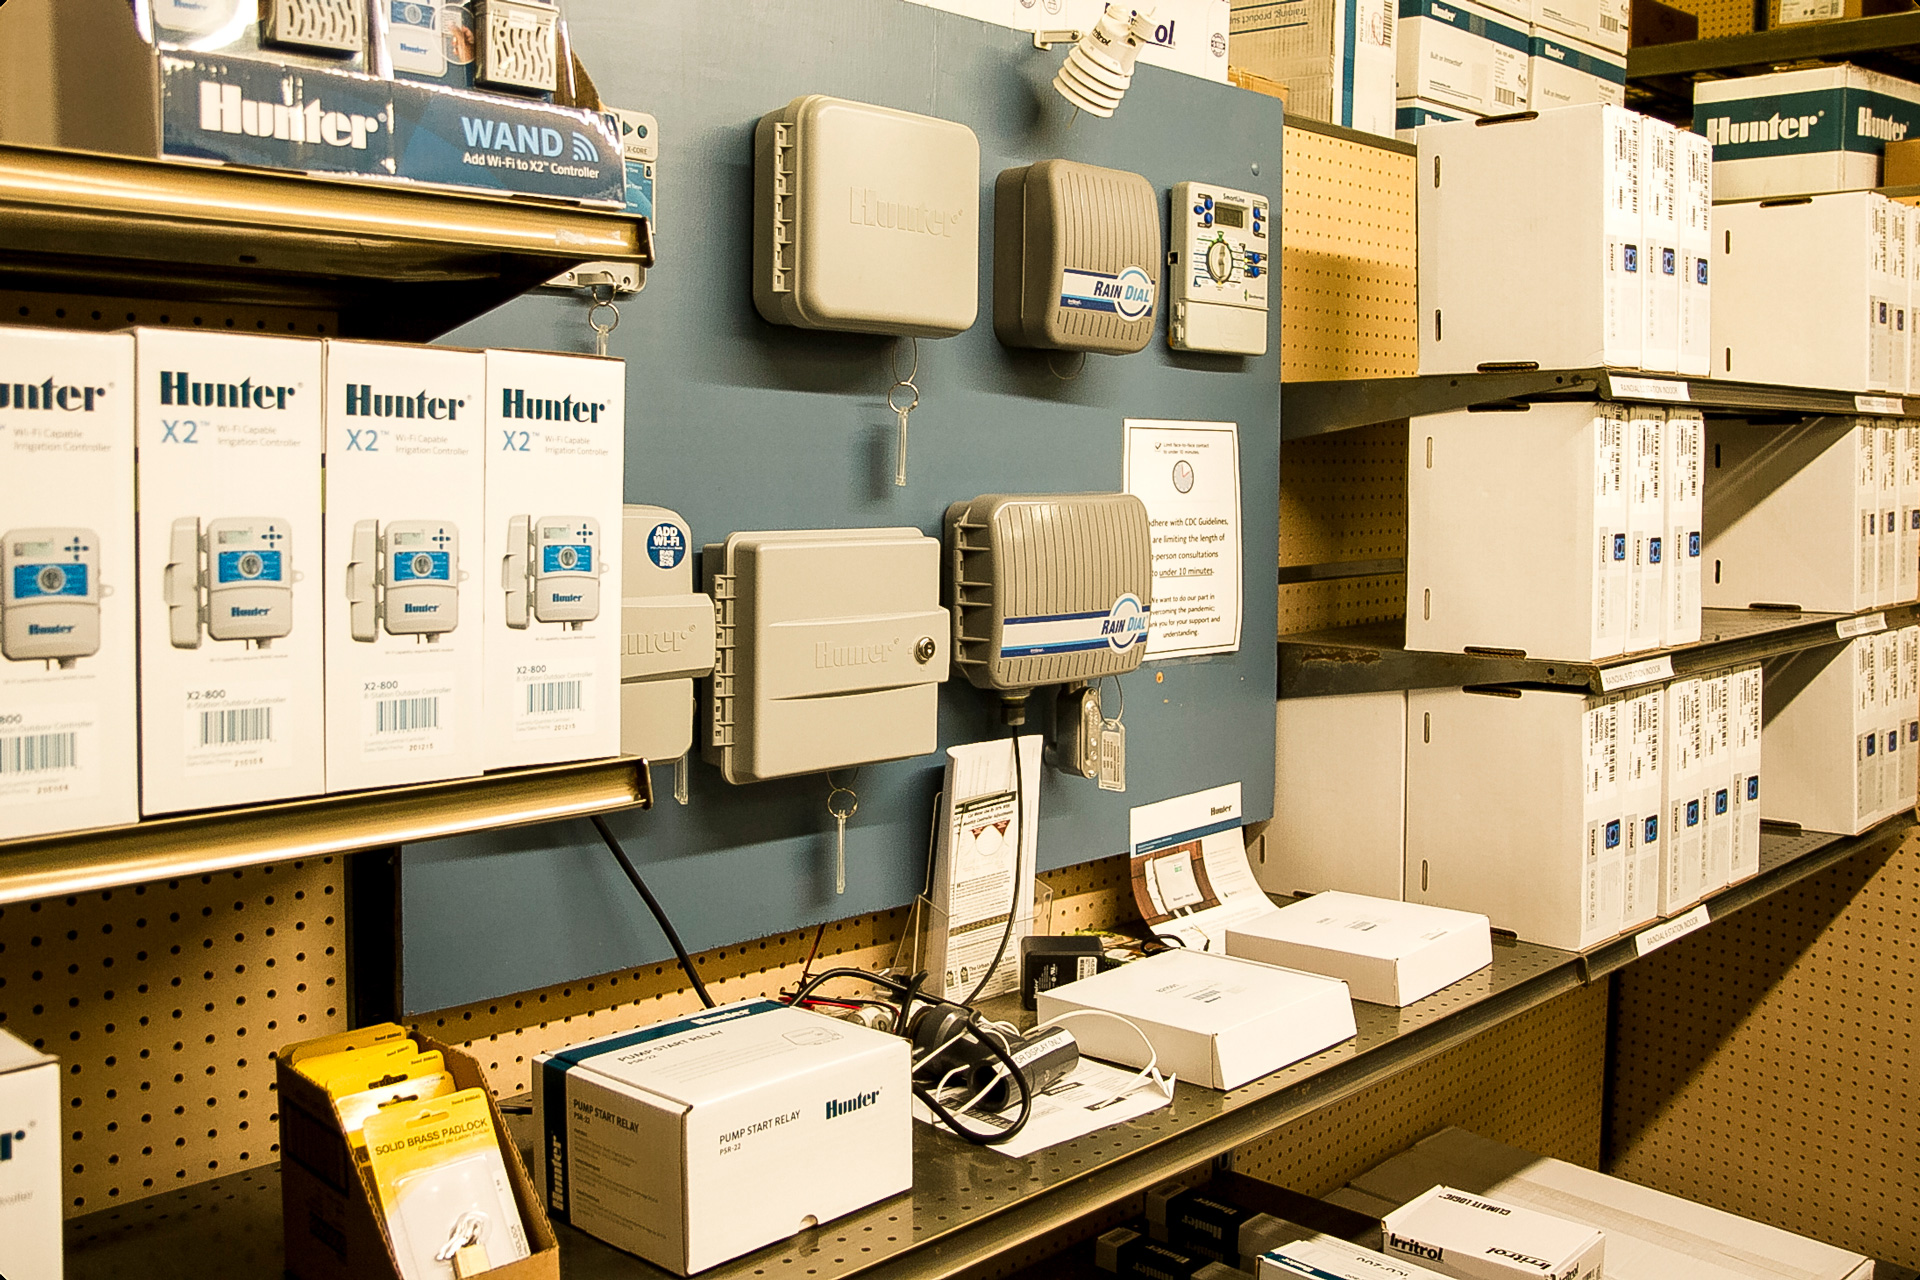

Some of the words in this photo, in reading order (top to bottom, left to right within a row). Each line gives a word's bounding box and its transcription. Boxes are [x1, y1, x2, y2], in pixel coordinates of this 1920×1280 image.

[1242, 12, 1272, 24] product
[200, 80, 379, 150] Hunter
[1856, 106, 1907, 141] Hunter
[461, 117, 563, 157] WAND
[1706, 112, 1818, 146] Hunter
[627, 145, 648, 155] X-CORE
[463, 152, 485, 166] Add
[487, 154, 516, 170] Wi-Fi
[517, 156, 528, 171] to
[550, 162, 600, 179] Controller
[850, 186, 962, 237] Hunter
[1094, 280, 1122, 299] RAIN
[1125, 283, 1151, 303] DIAL
[160, 371, 296, 410] Hunter
[346, 384, 465, 420] Hunter
[502, 388, 605, 423] Hunter
[655, 526, 678, 537] ADD
[1170, 518, 1183, 526] with
[1184, 518, 1197, 526] CDC
[653, 536, 680, 547] WI-FI
[1152, 536, 1162, 544] are
[1163, 533, 1187, 544] limiting
[1199, 533, 1218, 544] length
[1218, 533, 1225, 541] of
[1178, 551, 1219, 560] consultations
[1159, 568, 1177, 577] under
[1179, 568, 1187, 576] 10
[1187, 567, 1215, 576] minutes.
[552, 592, 583, 603] Hunter
[1197, 594, 1209, 602] part
[231, 606, 272, 617] Hunter
[404, 603, 440, 613] Hunter
[28, 624, 76, 636] Hunter
[1101, 618, 1126, 636] RAIN
[1127, 616, 1146, 632] DIAL
[1158, 619, 1168, 628] you
[1168, 618, 1176, 626] for
[1176, 618, 1188, 627] your
[1189, 616, 1210, 626] support
[815, 640, 894, 669] Hunter
[517, 665, 547, 674] X2-800
[187, 690, 226, 700] X2-800
[364, 680, 399, 691] X2-800
[1210, 805, 1232, 816] Hunter
[617, 1049, 652, 1063] PUMP
[653, 1039, 689, 1055] START
[689, 1029, 724, 1046] RELAY
[1015, 1054, 1026, 1065] OR
[1026, 1044, 1048, 1060] DISPLAY
[1047, 1036, 1065, 1050] ONLY
[825, 1088, 881, 1121] Hunter
[573, 1098, 593, 1114] PUMP
[594, 1107, 616, 1124] START
[616, 1116, 640, 1134] RELAY
[719, 1126, 746, 1145] PUMP
[746, 1118, 773, 1137] START
[774, 1109, 801, 1128] RELAY
[375, 1138, 405, 1156] SOLID
[407, 1130, 440, 1149] BRASS
[441, 1118, 488, 1139] PADLOCK
[719, 1142, 742, 1156] PSR-22
[552, 1135, 562, 1211] Hunter
[1193, 1198, 1238, 1215] Hunter
[1469, 1199, 1512, 1216] CLIMATE
[1181, 1214, 1223, 1240] Hunter
[1145, 1245, 1190, 1264] Hunter
[1389, 1233, 1444, 1263] Irritrol
[1484, 1246, 1553, 1272] Irritrol
